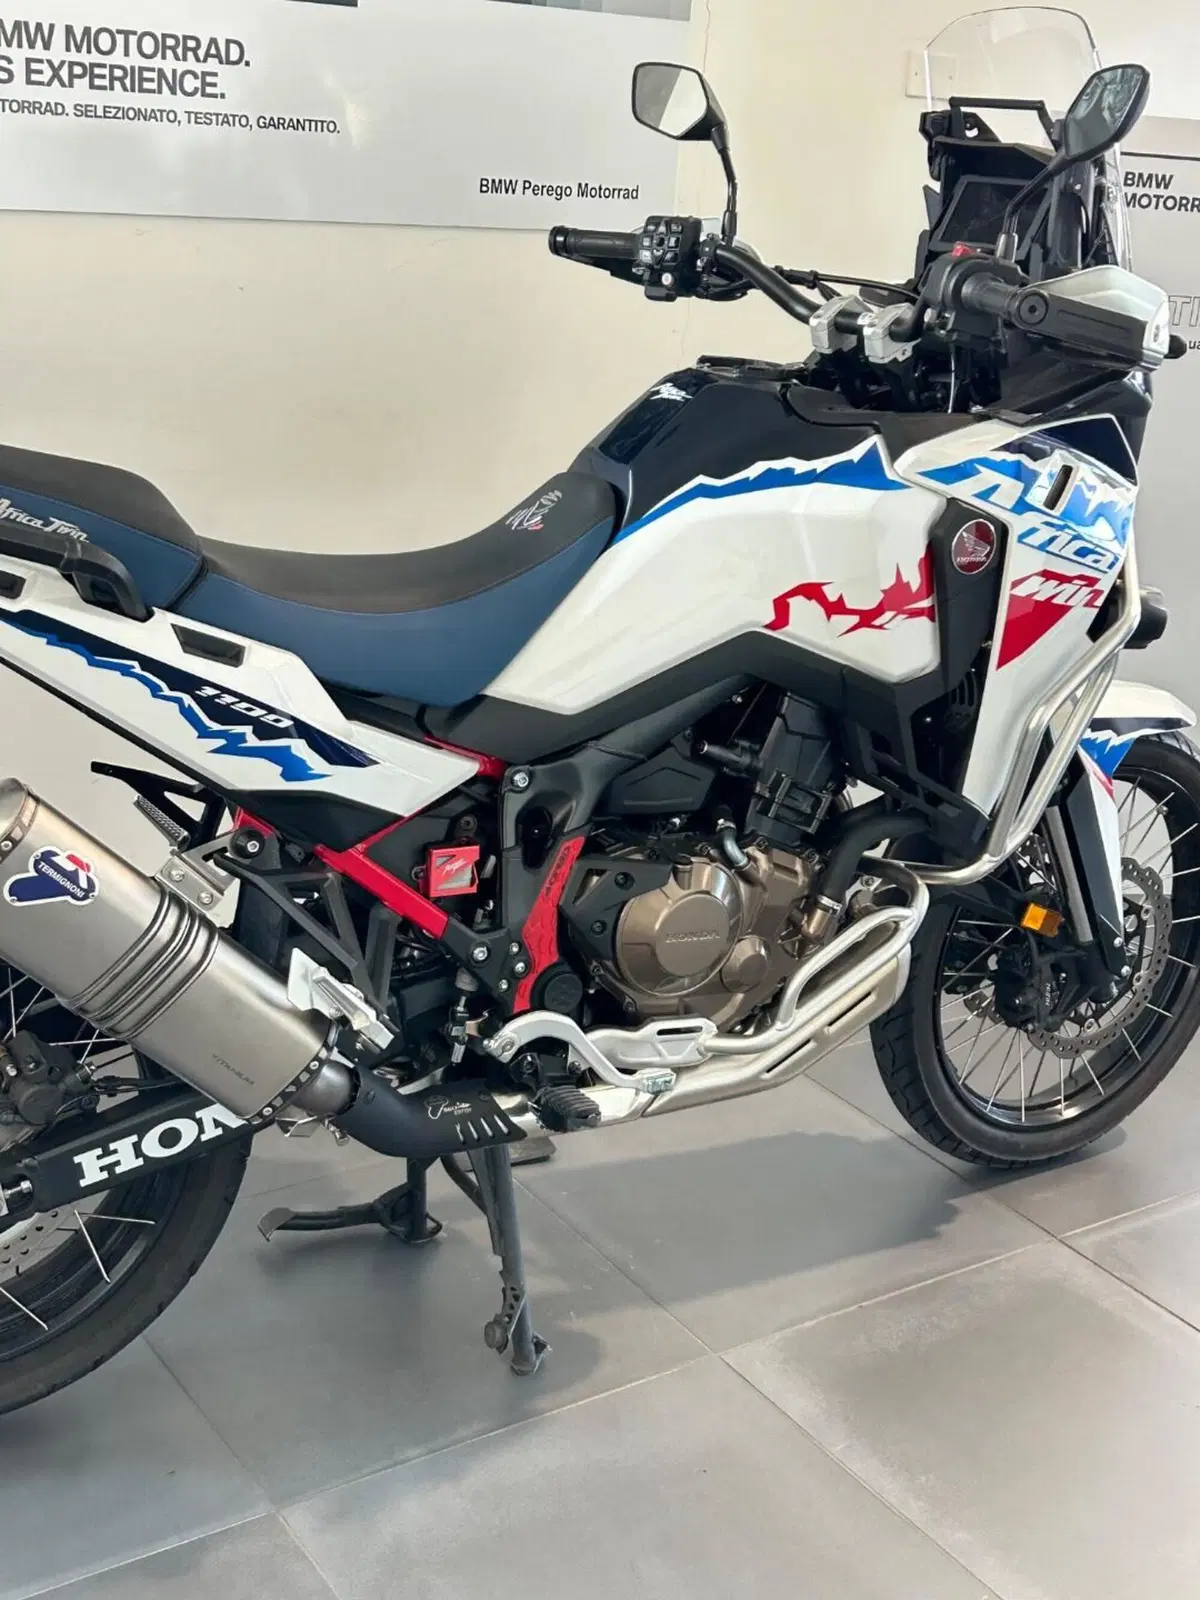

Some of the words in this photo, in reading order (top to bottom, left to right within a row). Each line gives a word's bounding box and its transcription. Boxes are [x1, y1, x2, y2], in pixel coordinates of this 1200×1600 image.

[64, 24, 251, 68] MOTORRAD.
[25, 57, 226, 99] EXPERIENCE.
[73, 103, 182, 127] SELEZIONATO,
[184, 110, 253, 131] TESTATO,
[256, 115, 341, 134] GARANTITO.
[479, 177, 518, 195] BMW
[522, 179, 573, 201] Perego
[577, 182, 640, 200] Motorrad
[1123, 171, 1174, 190] BMW
[43, 516, 90, 543] Twin
[195, 685, 294, 728] 1100
[37, 860, 86, 899] TERMIGNONI
